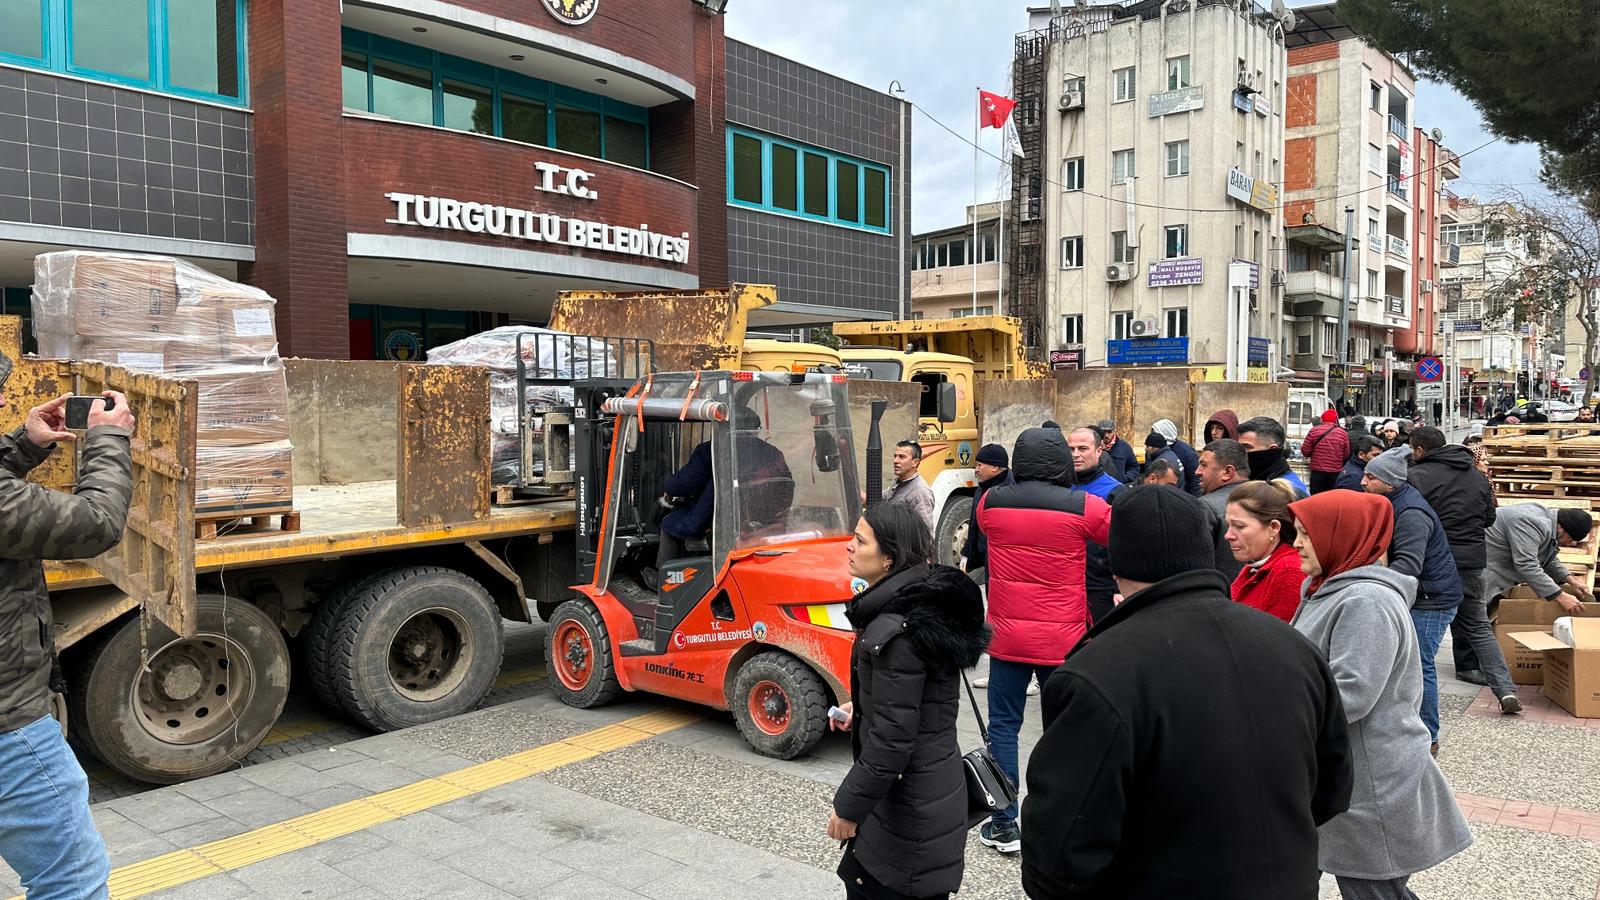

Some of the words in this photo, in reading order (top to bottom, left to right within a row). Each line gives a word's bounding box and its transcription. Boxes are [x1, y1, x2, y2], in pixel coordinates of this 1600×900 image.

[534, 161, 598, 200] T.C.
[385, 192, 561, 243] TURGUTLU
[568, 223, 690, 265] BELEDİYESİ
[665, 571, 685, 584] 30
[711, 621, 723, 631] T.C.
[686, 633, 717, 644] TURGUTLU
[718, 627, 753, 641] BELEDİYESİ
[1516, 662, 1543, 670] ASTİK
